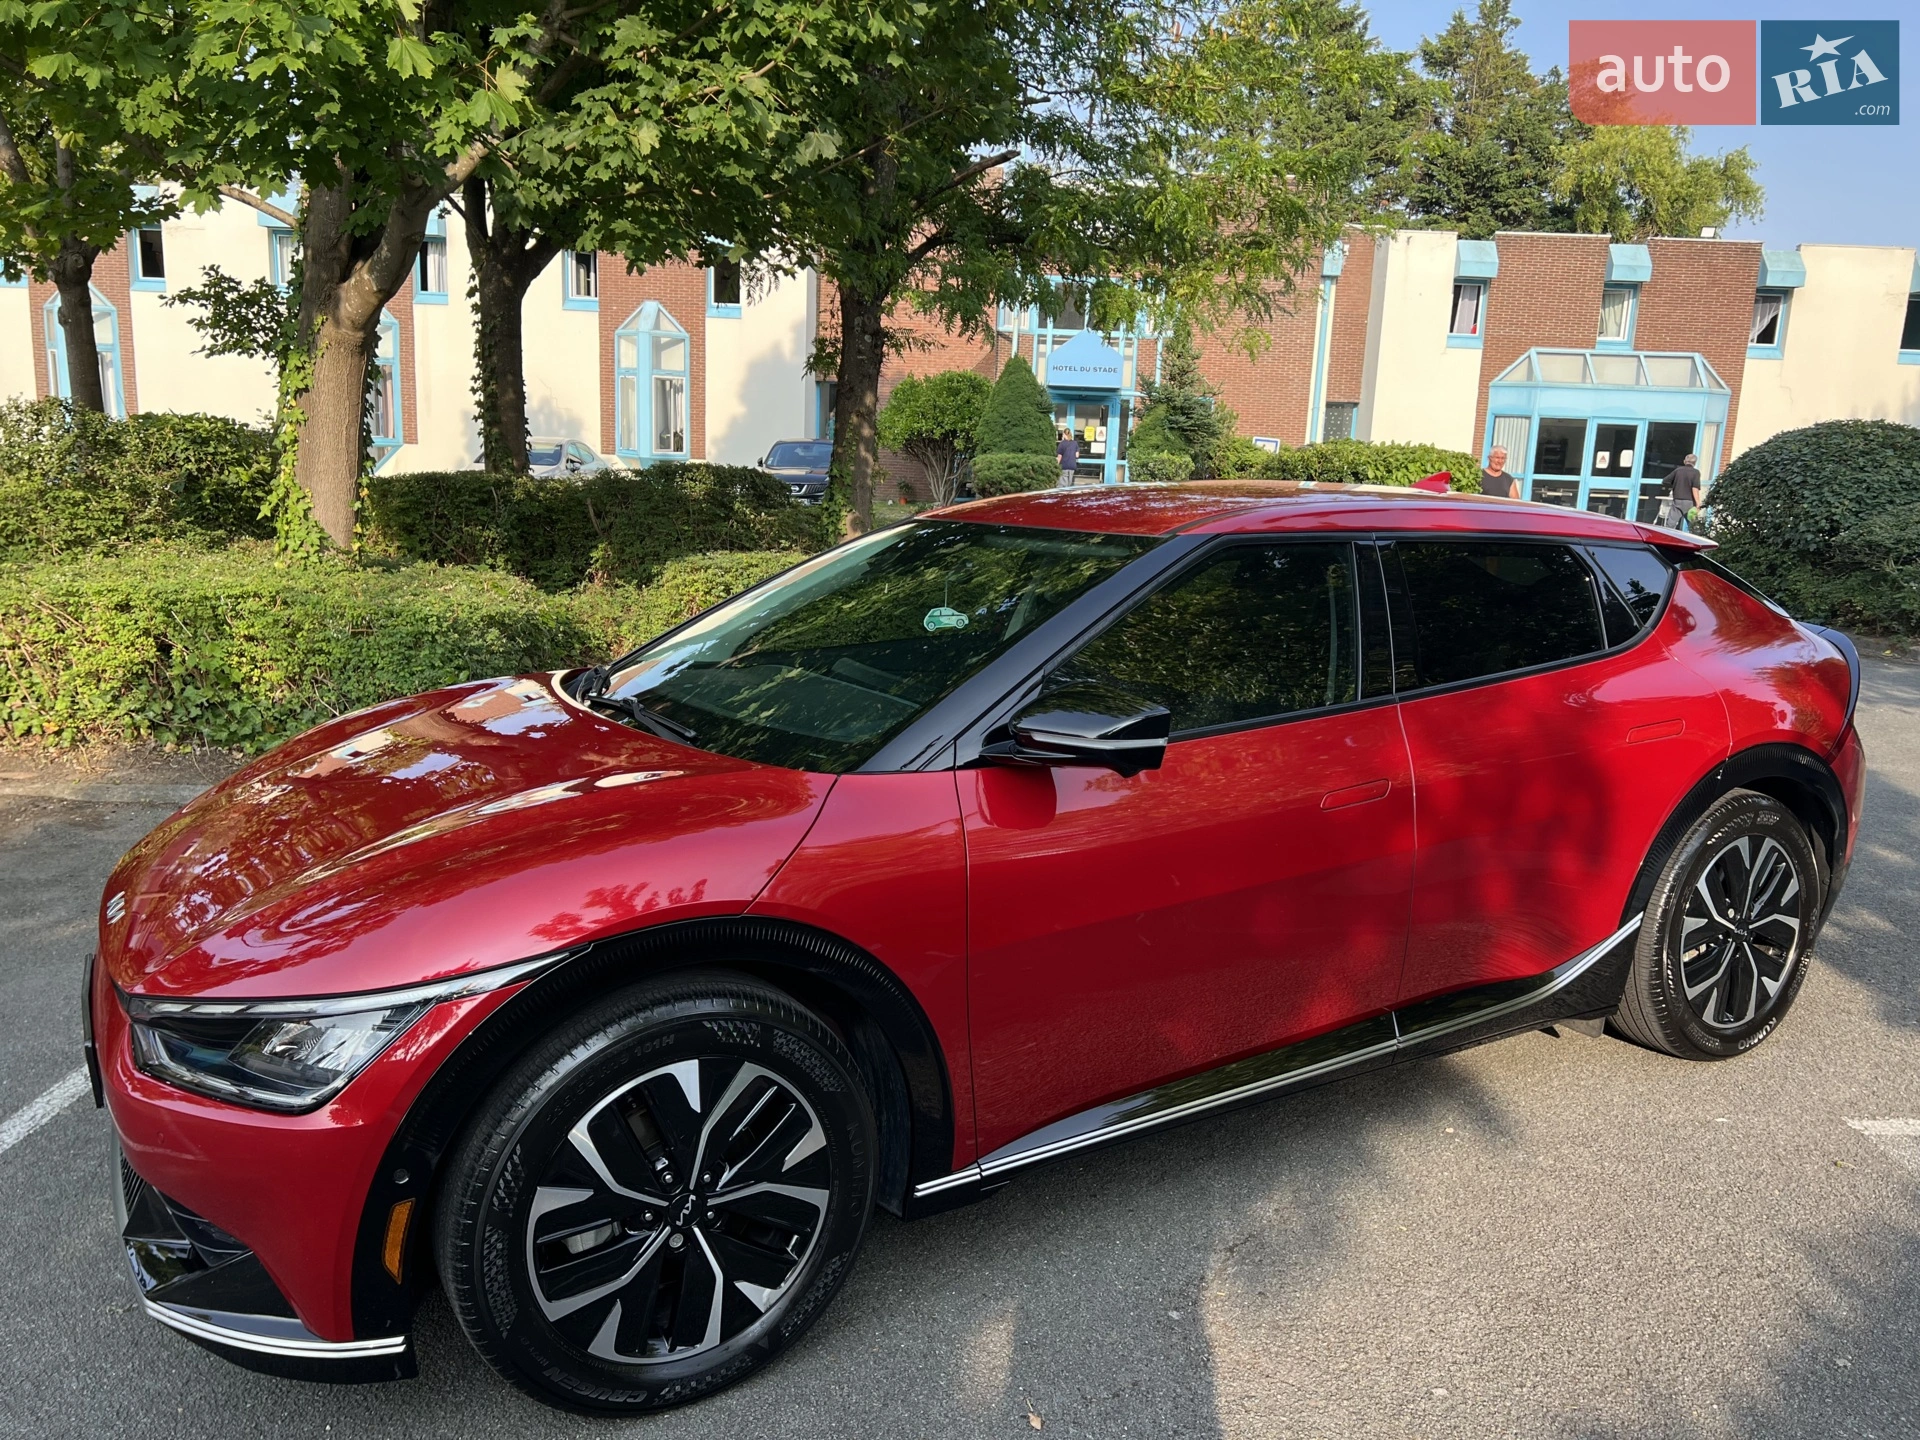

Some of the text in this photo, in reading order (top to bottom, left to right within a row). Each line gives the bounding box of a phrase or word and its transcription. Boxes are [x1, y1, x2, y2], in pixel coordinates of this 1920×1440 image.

[1052, 365, 1078, 373] HOTEL
[633, 1033, 676, 1057] 101H
[1737, 1017, 1777, 1050] KUMHO
[846, 1119, 866, 1218] KUMHO
[541, 1364, 649, 1404] CRUGEN
